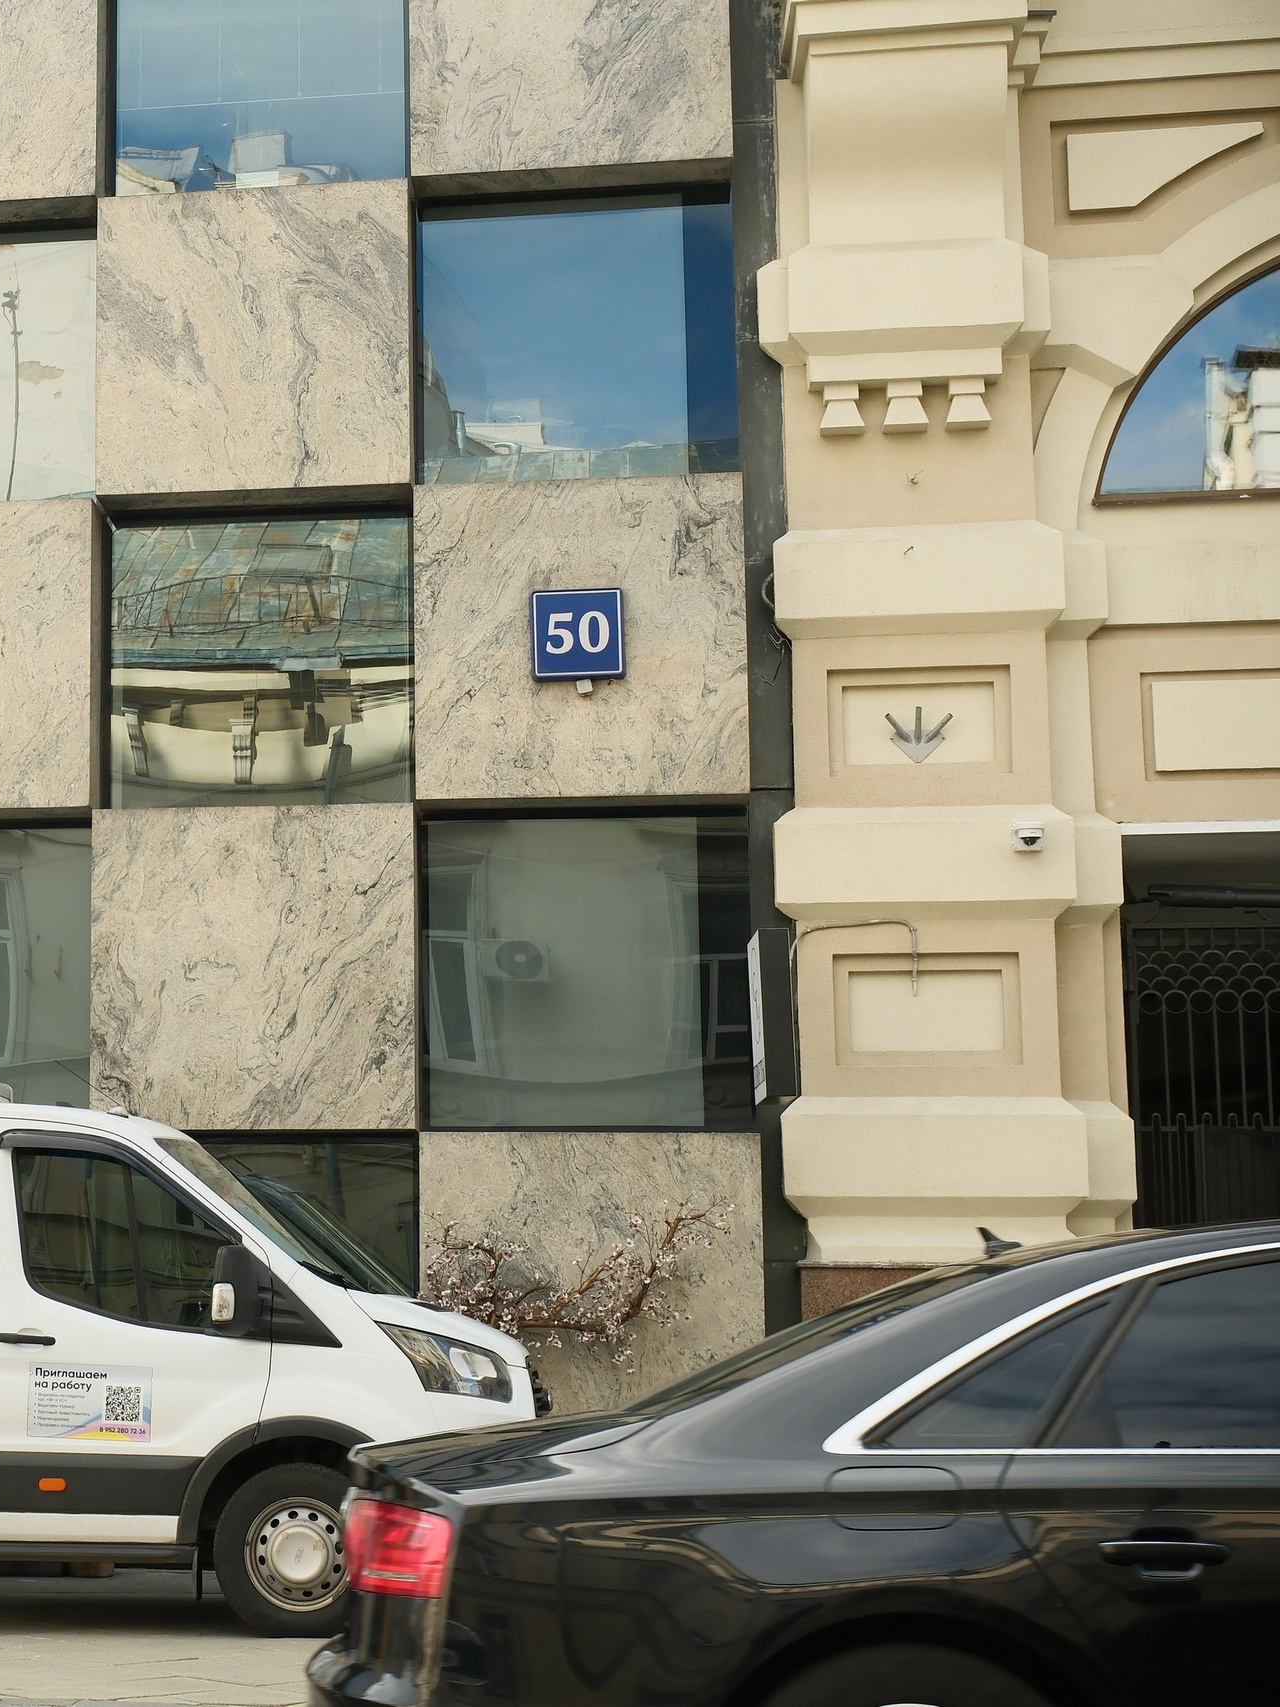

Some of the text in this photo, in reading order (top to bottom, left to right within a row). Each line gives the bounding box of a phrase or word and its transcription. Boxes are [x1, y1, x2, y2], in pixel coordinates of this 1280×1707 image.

[546, 611, 610, 654] 50
[35, 1367, 108, 1380] Приглашаем
[51, 1380, 92, 1392] работу
